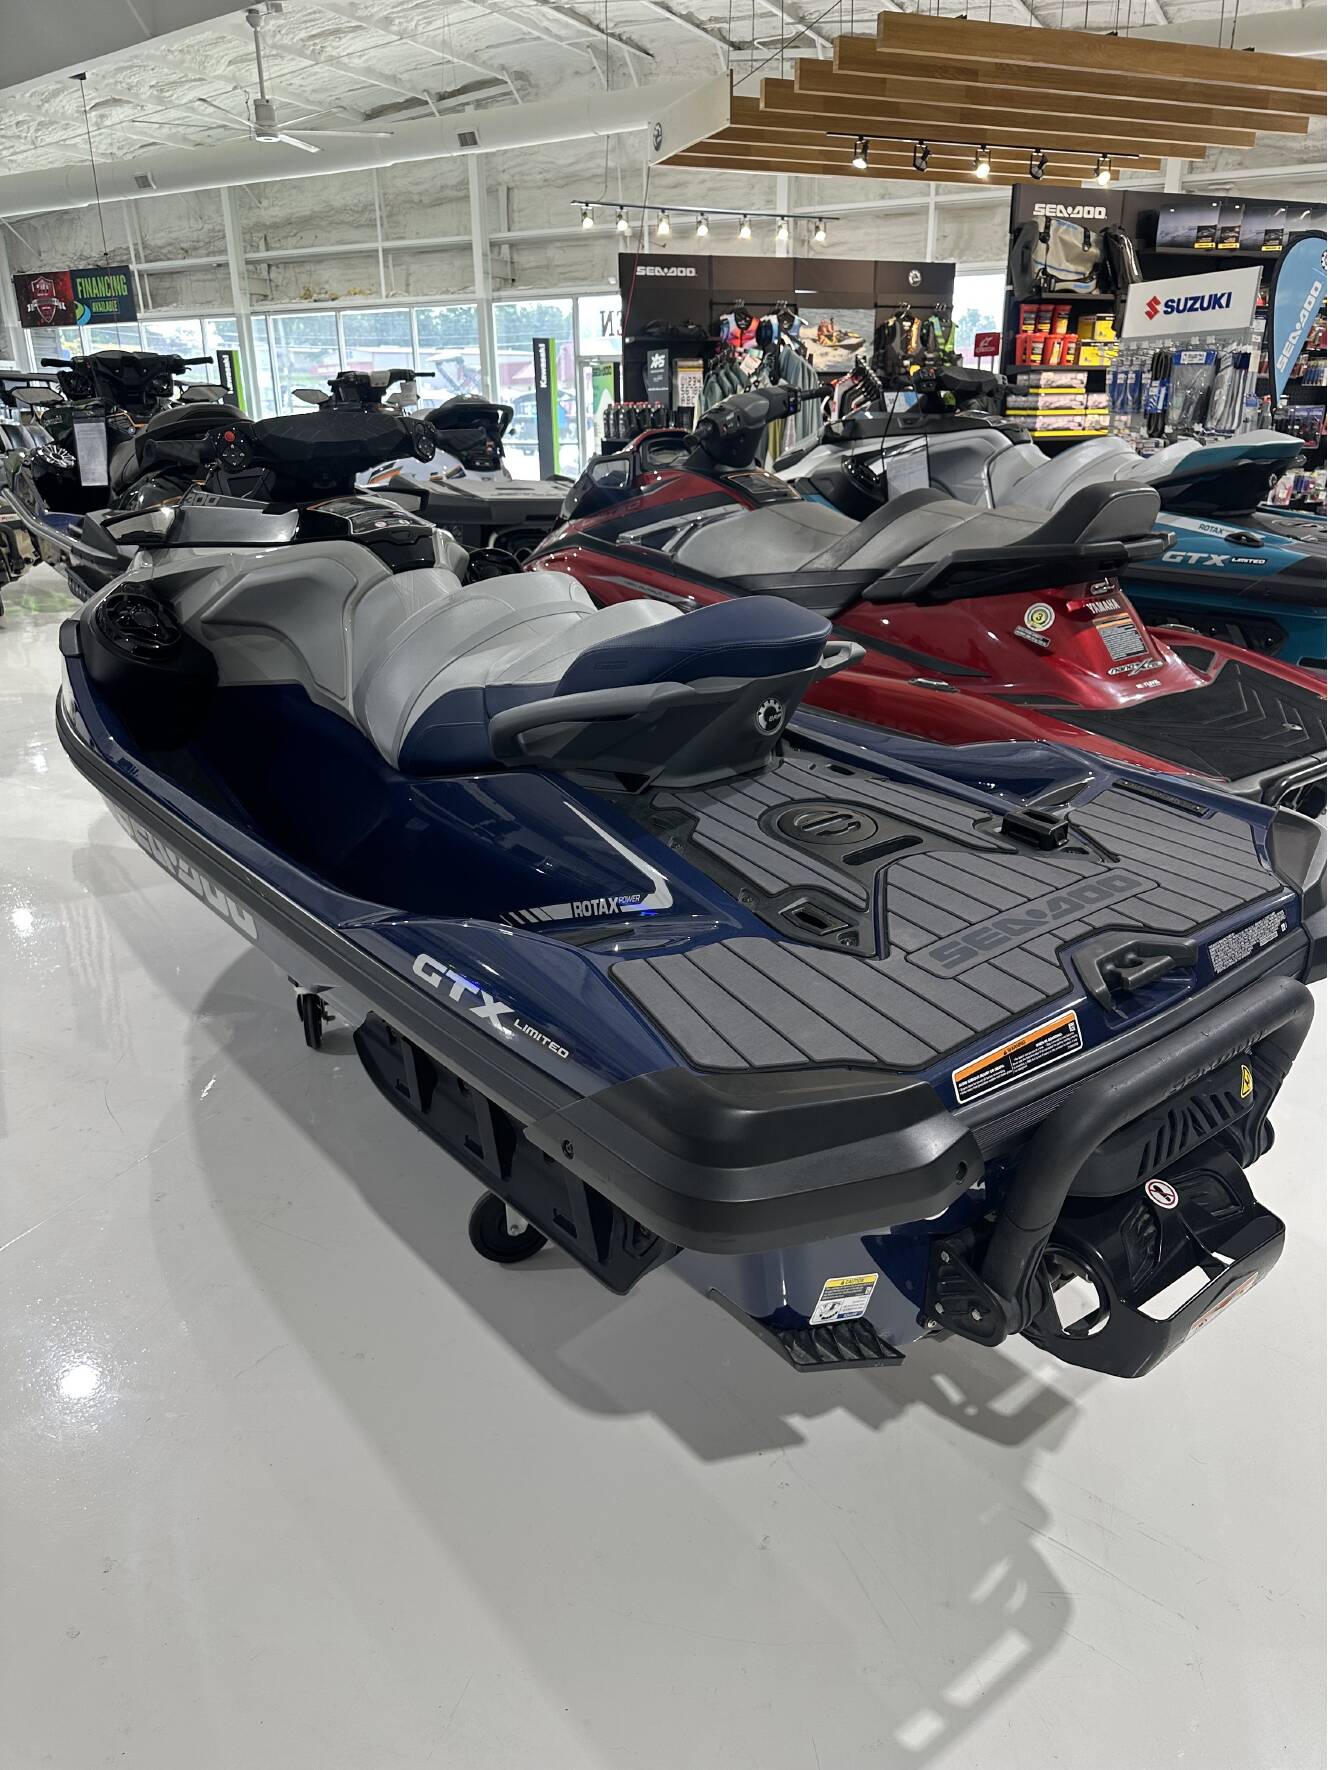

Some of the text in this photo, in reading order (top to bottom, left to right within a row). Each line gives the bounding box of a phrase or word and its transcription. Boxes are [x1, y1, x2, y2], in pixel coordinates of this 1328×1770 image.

[76, 274, 128, 298] FINANCING
[92, 300, 118, 313] AVAILABLE
[1162, 291, 1232, 315] SUZUKI
[538, 343, 548, 388] Kawasaki
[1199, 523, 1224, 534] ROTAX
[1162, 551, 1266, 567] GTX LIMITED
[1086, 599, 1121, 614] YAMAHA
[573, 894, 641, 918] ROTAX POWER
[412, 953, 570, 1059] GTX LIMITED
